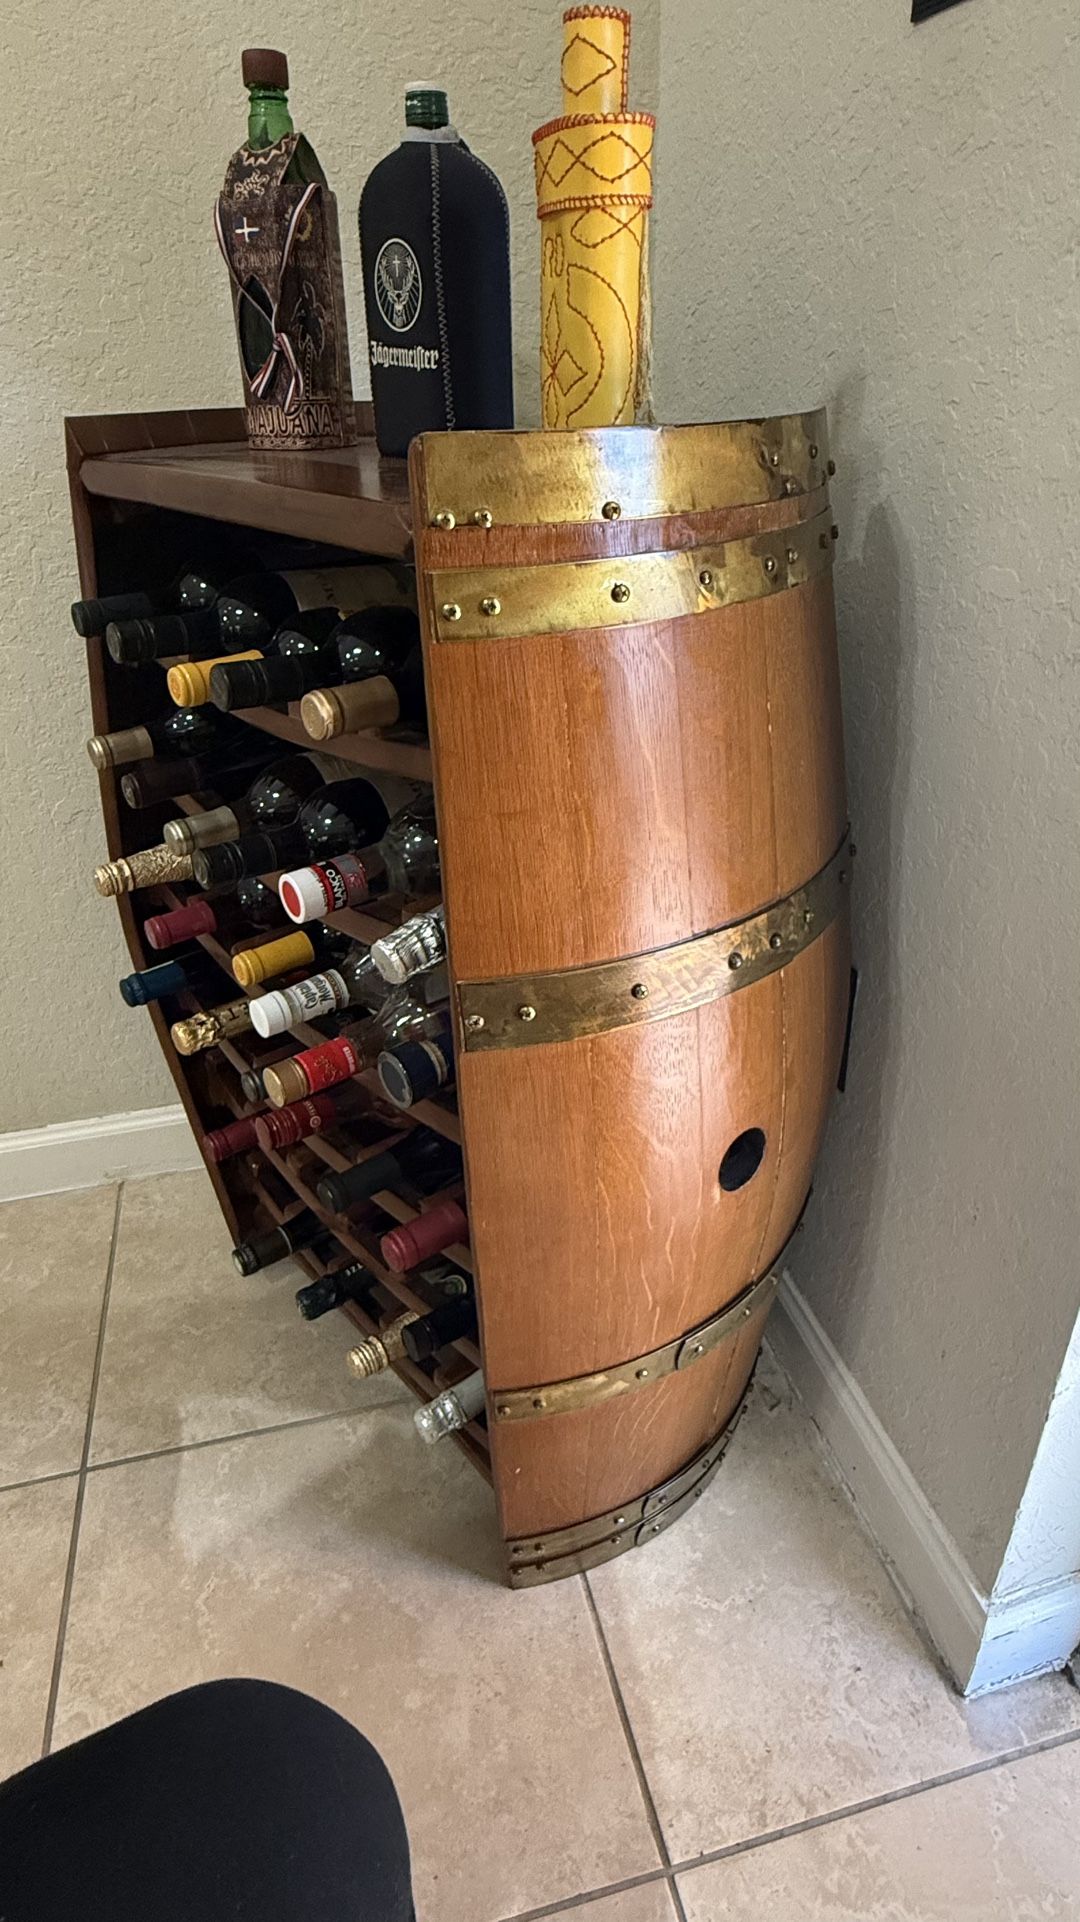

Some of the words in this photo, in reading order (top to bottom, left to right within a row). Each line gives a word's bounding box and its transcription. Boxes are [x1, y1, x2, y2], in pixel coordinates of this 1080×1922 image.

[370, 340, 439, 372] Jägermeister
[296, 982, 318, 1009] Capta
[312, 976, 334, 1002] Morg
